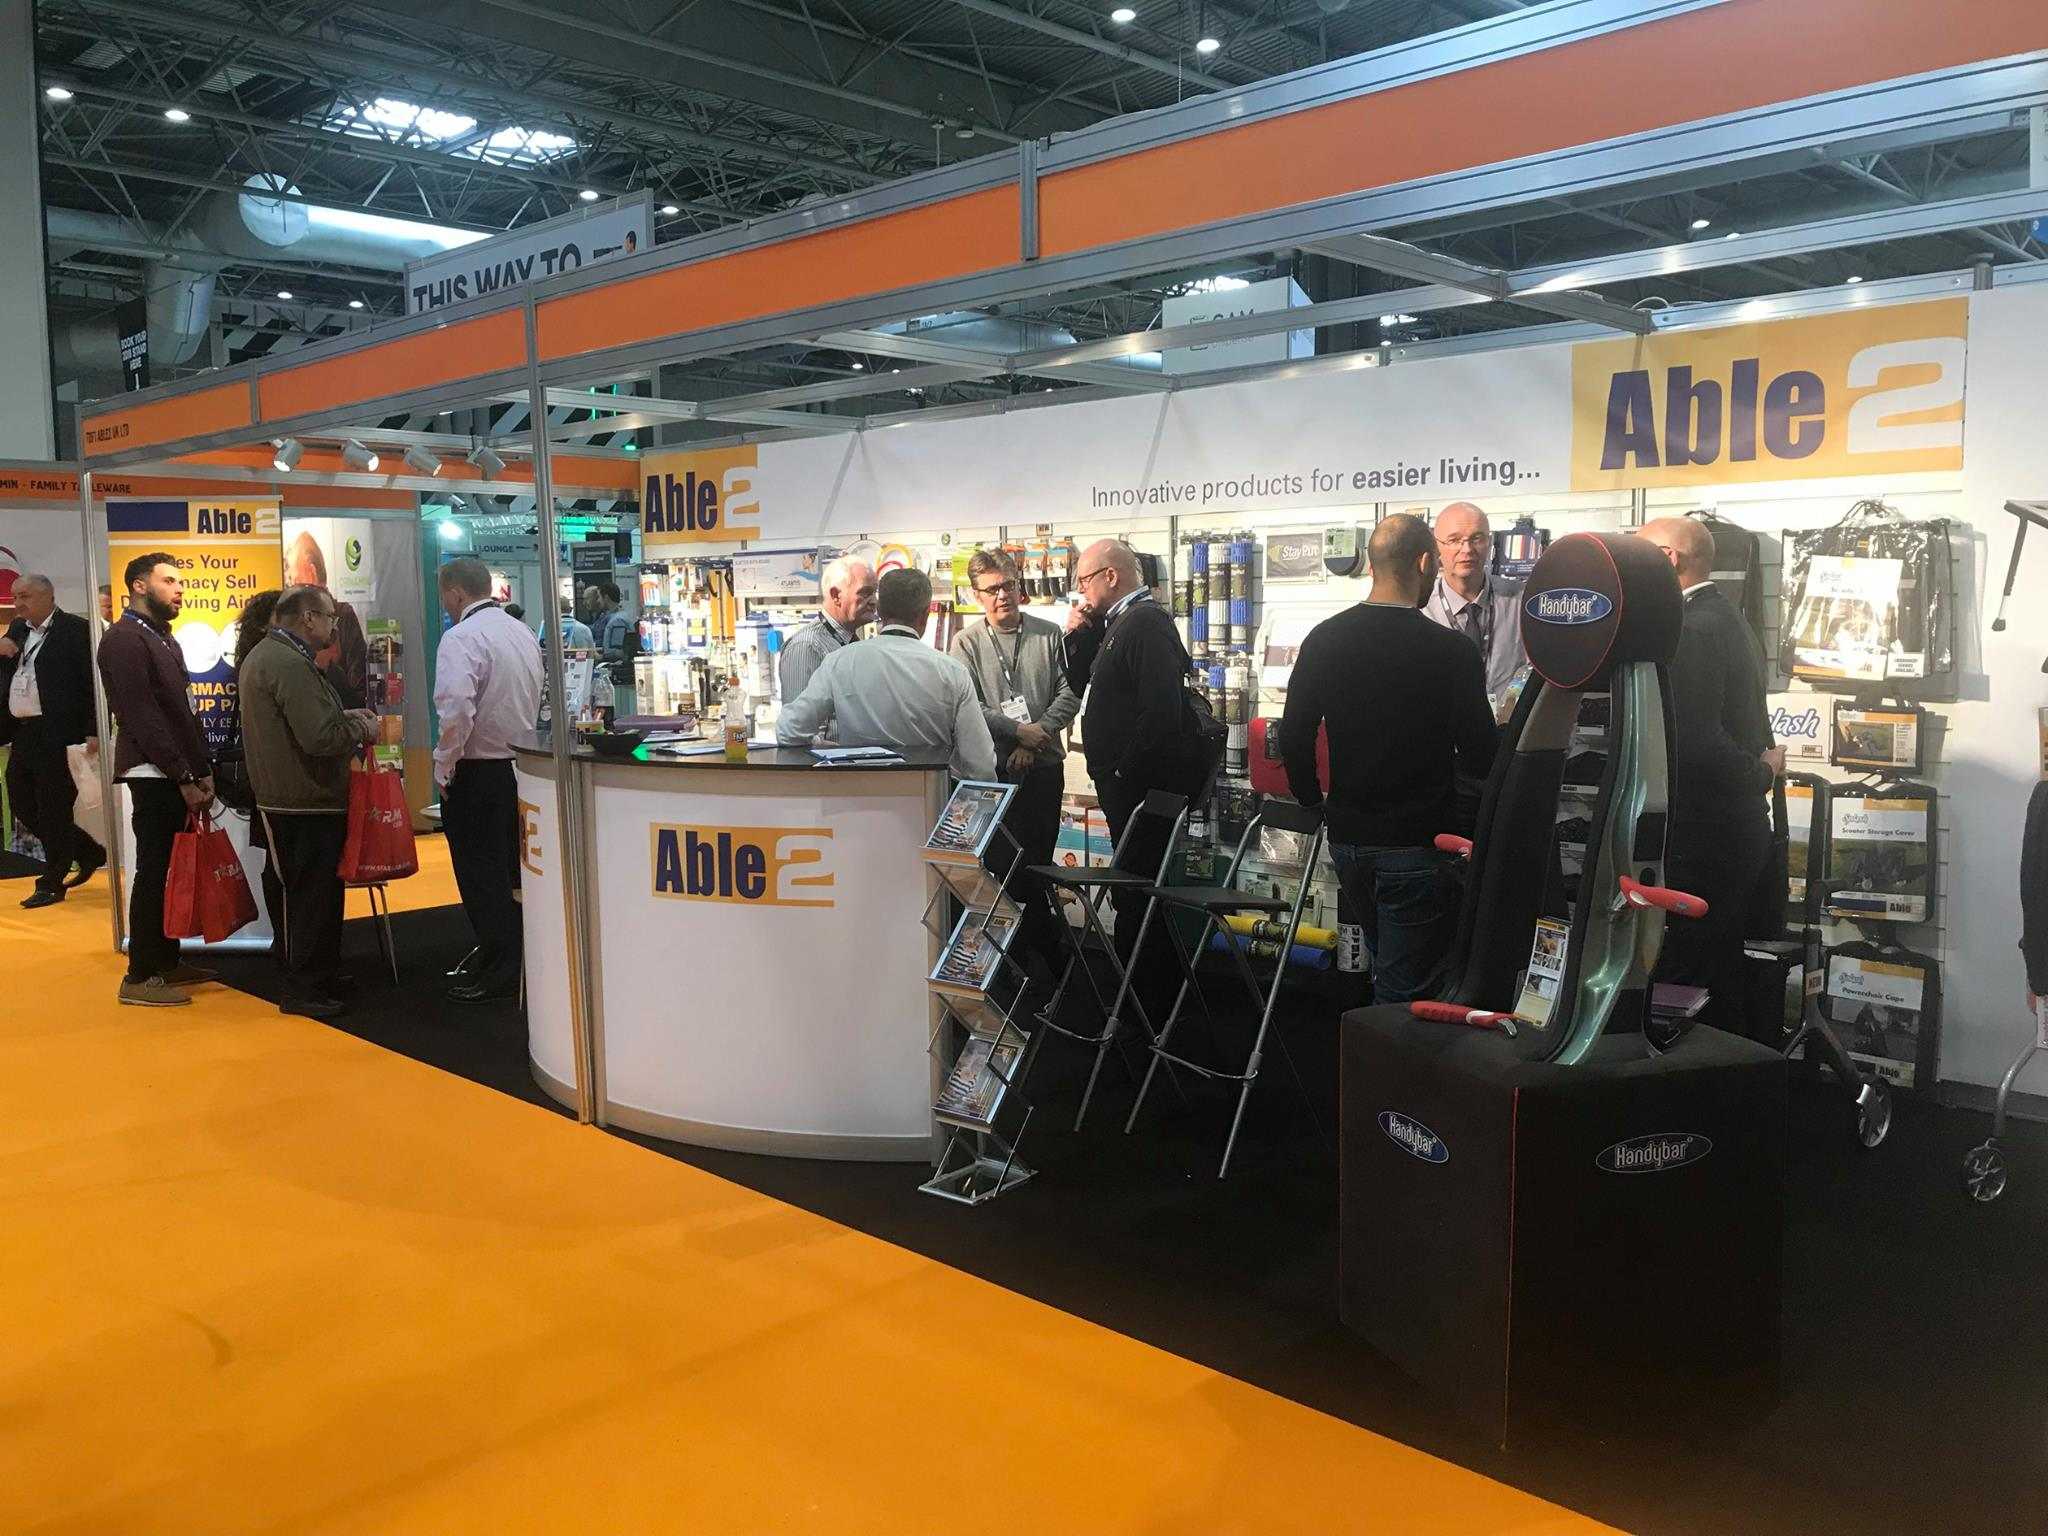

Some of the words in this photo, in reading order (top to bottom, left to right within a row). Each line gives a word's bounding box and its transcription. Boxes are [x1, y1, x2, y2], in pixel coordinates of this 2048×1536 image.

[413, 274, 467, 312] THIS
[475, 254, 534, 294] WAY
[540, 243, 582, 275] TO
[30, 480, 67, 491] FAMILY
[70, 481, 131, 494] TLEWARE
[1092, 480, 1196, 508] Innovative
[1202, 472, 1303, 510] products
[1311, 467, 1344, 493] for
[1352, 462, 1431, 490] easier
[1440, 457, 1541, 487] living...
[480, 544, 514, 553] LOUNGE
[200, 555, 239, 569] Your
[226, 575, 257, 589] Sell
[1842, 827, 1866, 835] Scooter
[1867, 828, 1893, 837] Storage
